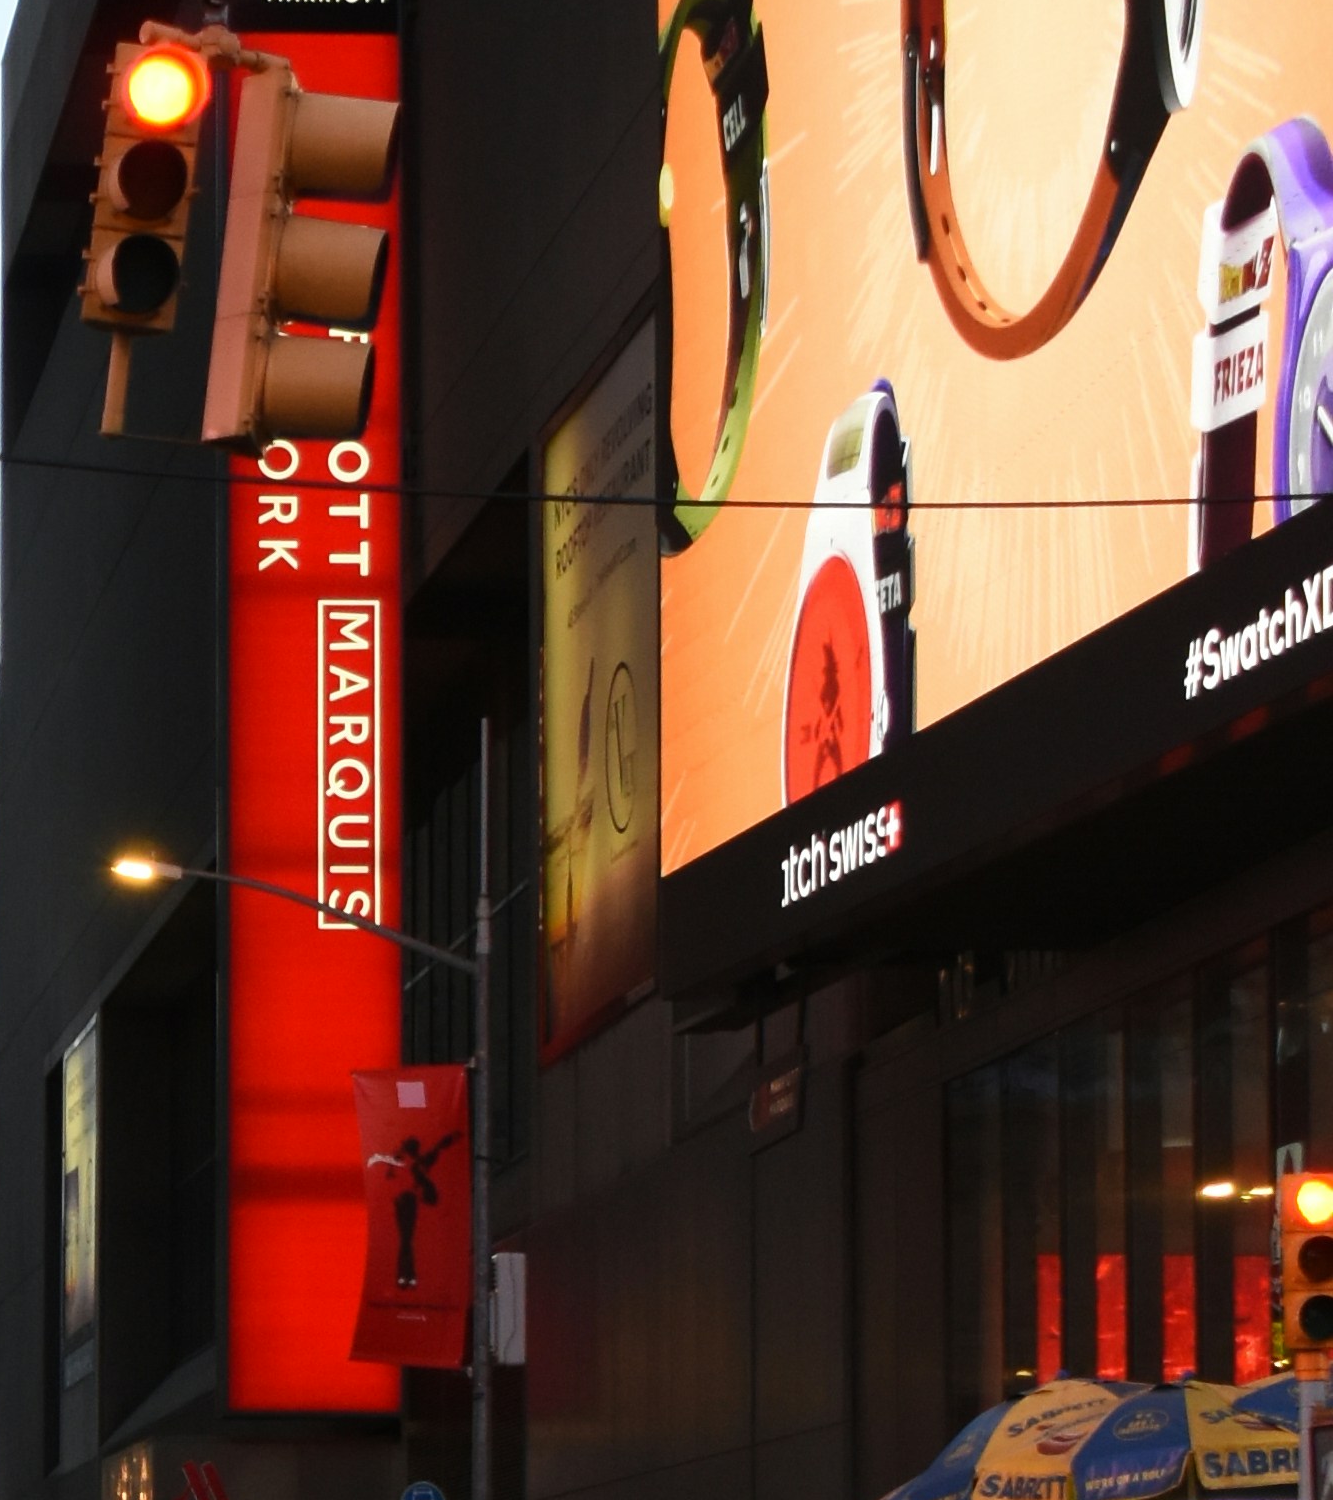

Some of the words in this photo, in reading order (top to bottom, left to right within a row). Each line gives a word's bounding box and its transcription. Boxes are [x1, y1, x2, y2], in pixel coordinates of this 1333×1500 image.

[723, 93, 746, 152] CELL
[1214, 341, 1264, 406] FRIEZA
[326, 611, 371, 921] MARQUIS
[980, 1474, 1066, 1500] SABRETT
